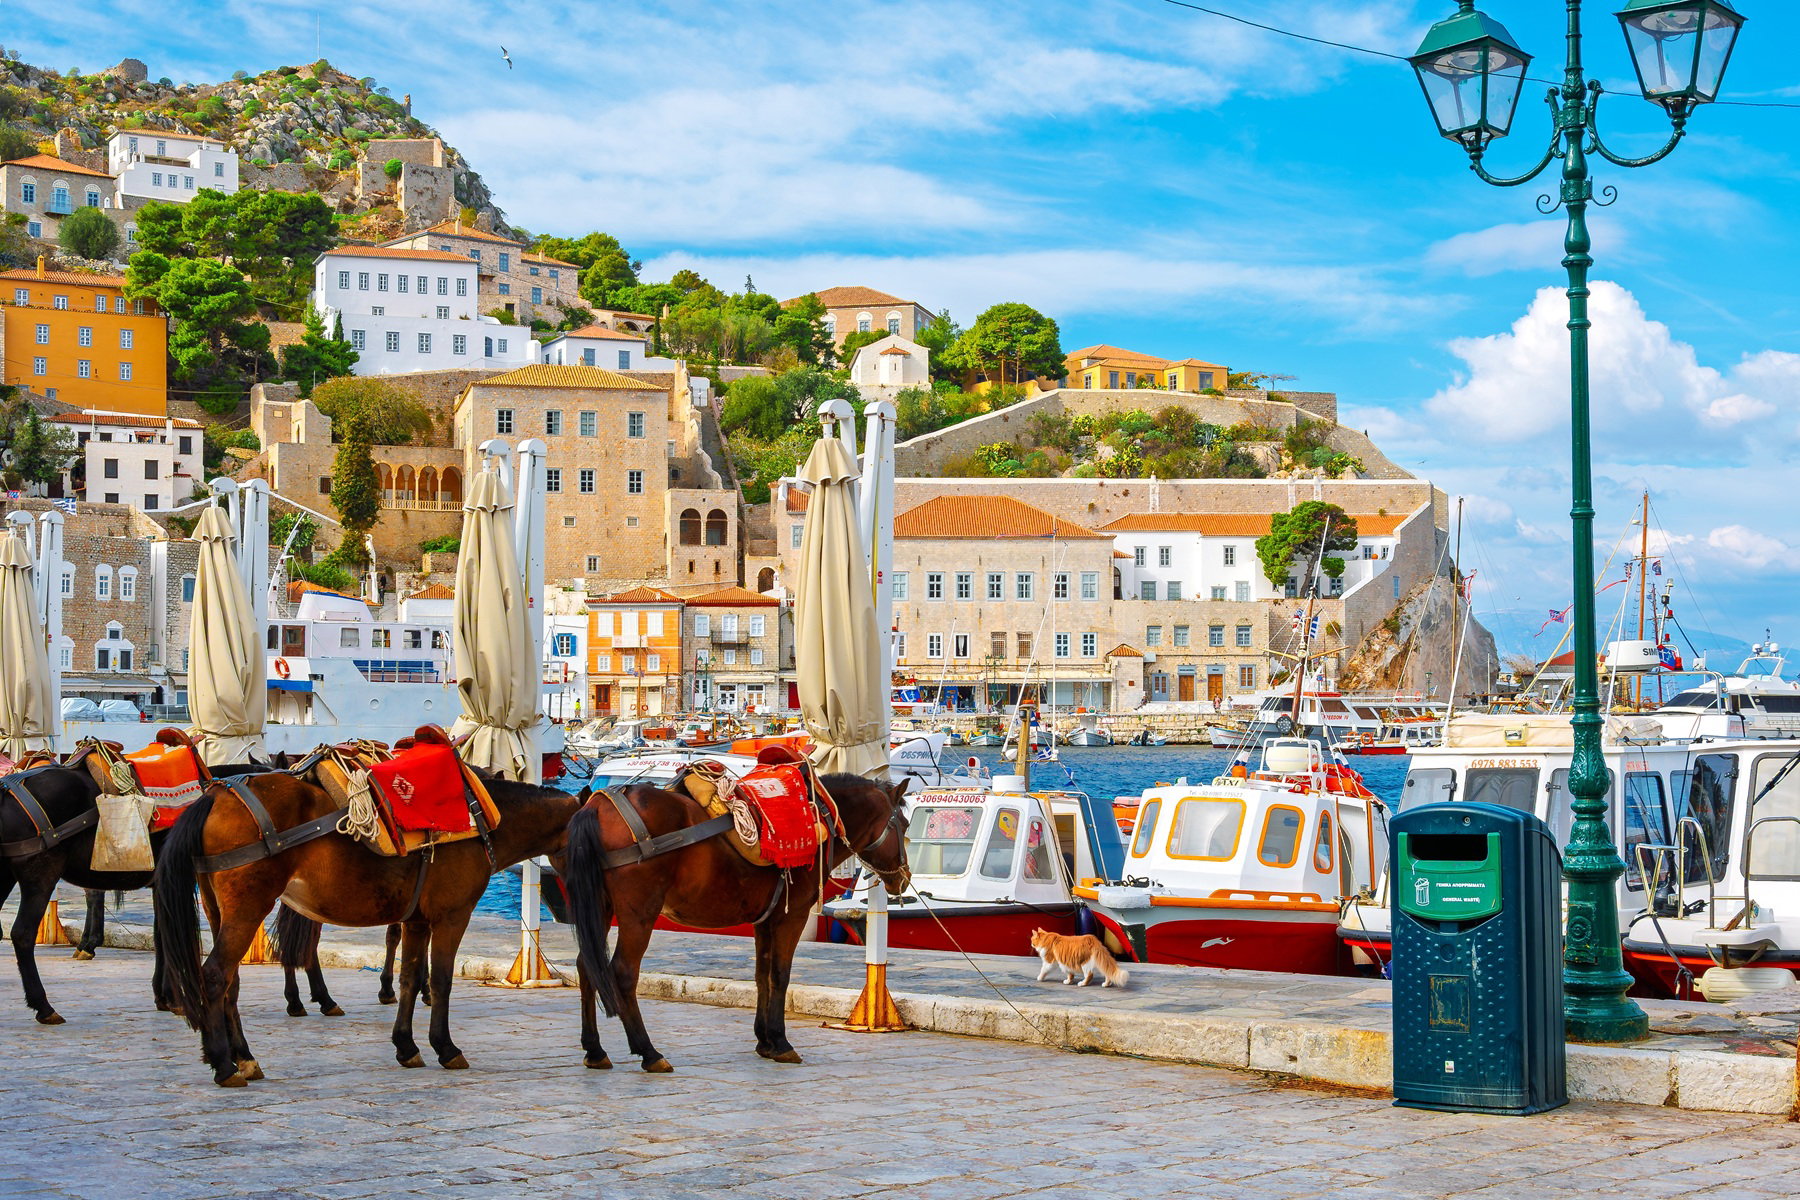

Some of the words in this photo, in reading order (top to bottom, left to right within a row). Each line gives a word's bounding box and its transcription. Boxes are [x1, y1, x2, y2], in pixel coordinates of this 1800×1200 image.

[1471, 759, 1495, 768] 6978
[1498, 759, 1517, 768] 883
[1520, 759, 1538, 768] 553
